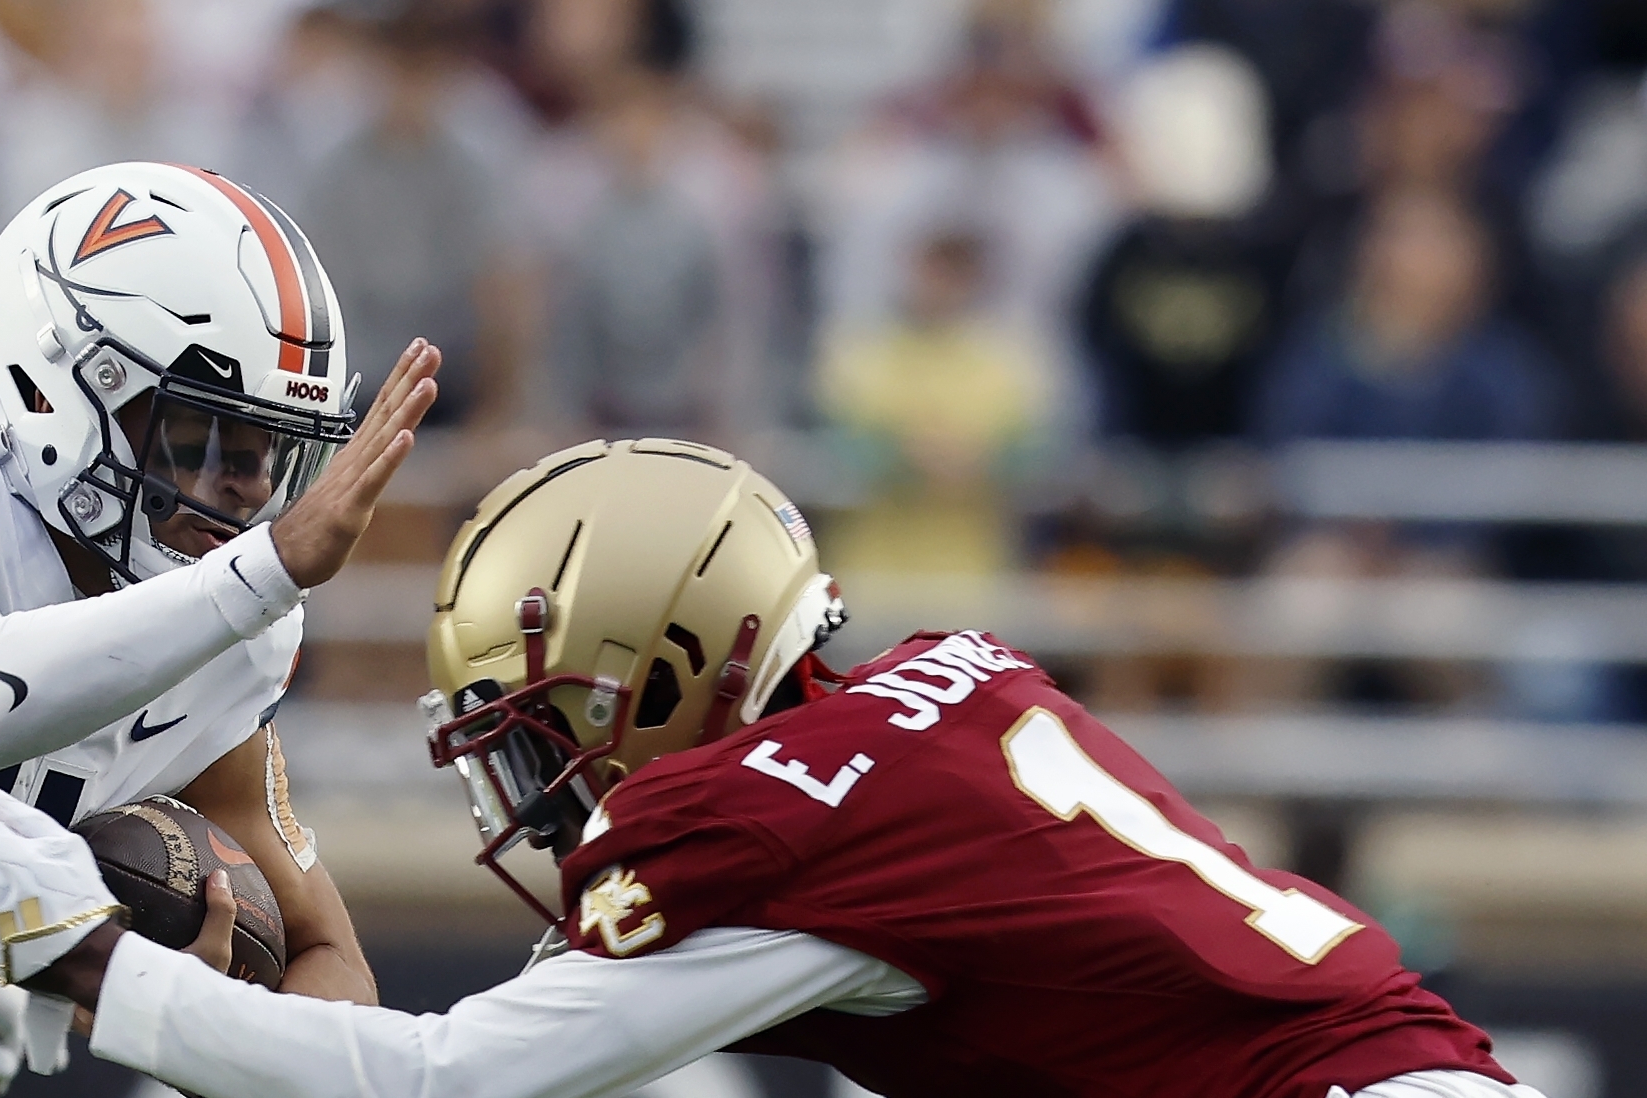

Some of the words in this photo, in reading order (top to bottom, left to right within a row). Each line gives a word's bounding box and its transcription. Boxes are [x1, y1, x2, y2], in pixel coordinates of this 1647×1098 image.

[285, 380, 330, 403] HOOS
[740, 739, 876, 809] E.
[999, 704, 1367, 966] 1
